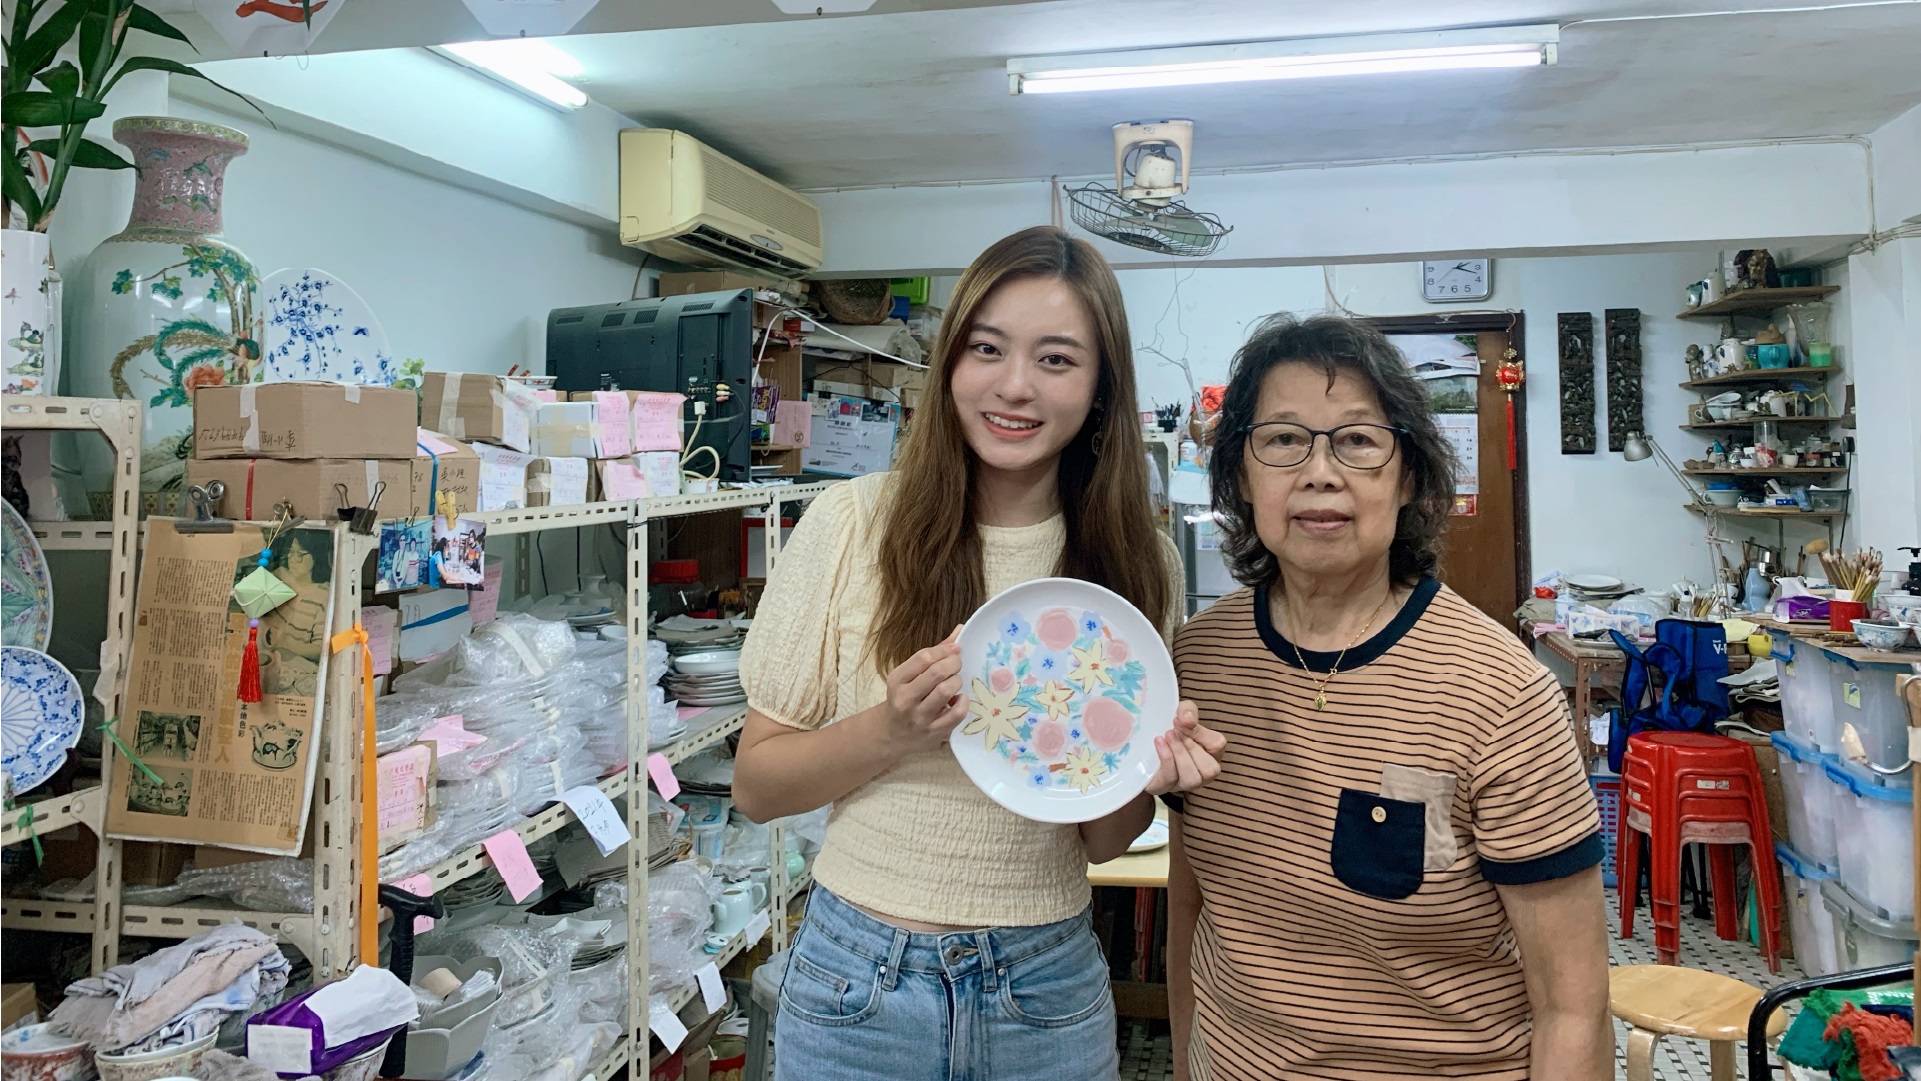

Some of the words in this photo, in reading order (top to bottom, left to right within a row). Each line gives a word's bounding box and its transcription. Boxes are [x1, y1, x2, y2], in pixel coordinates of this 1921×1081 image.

[1438, 285, 1445, 293] 7
[1451, 285, 1458, 293] 6
[1464, 284, 1471, 293] 5
[237, 702, 249, 738] 本地色彩
